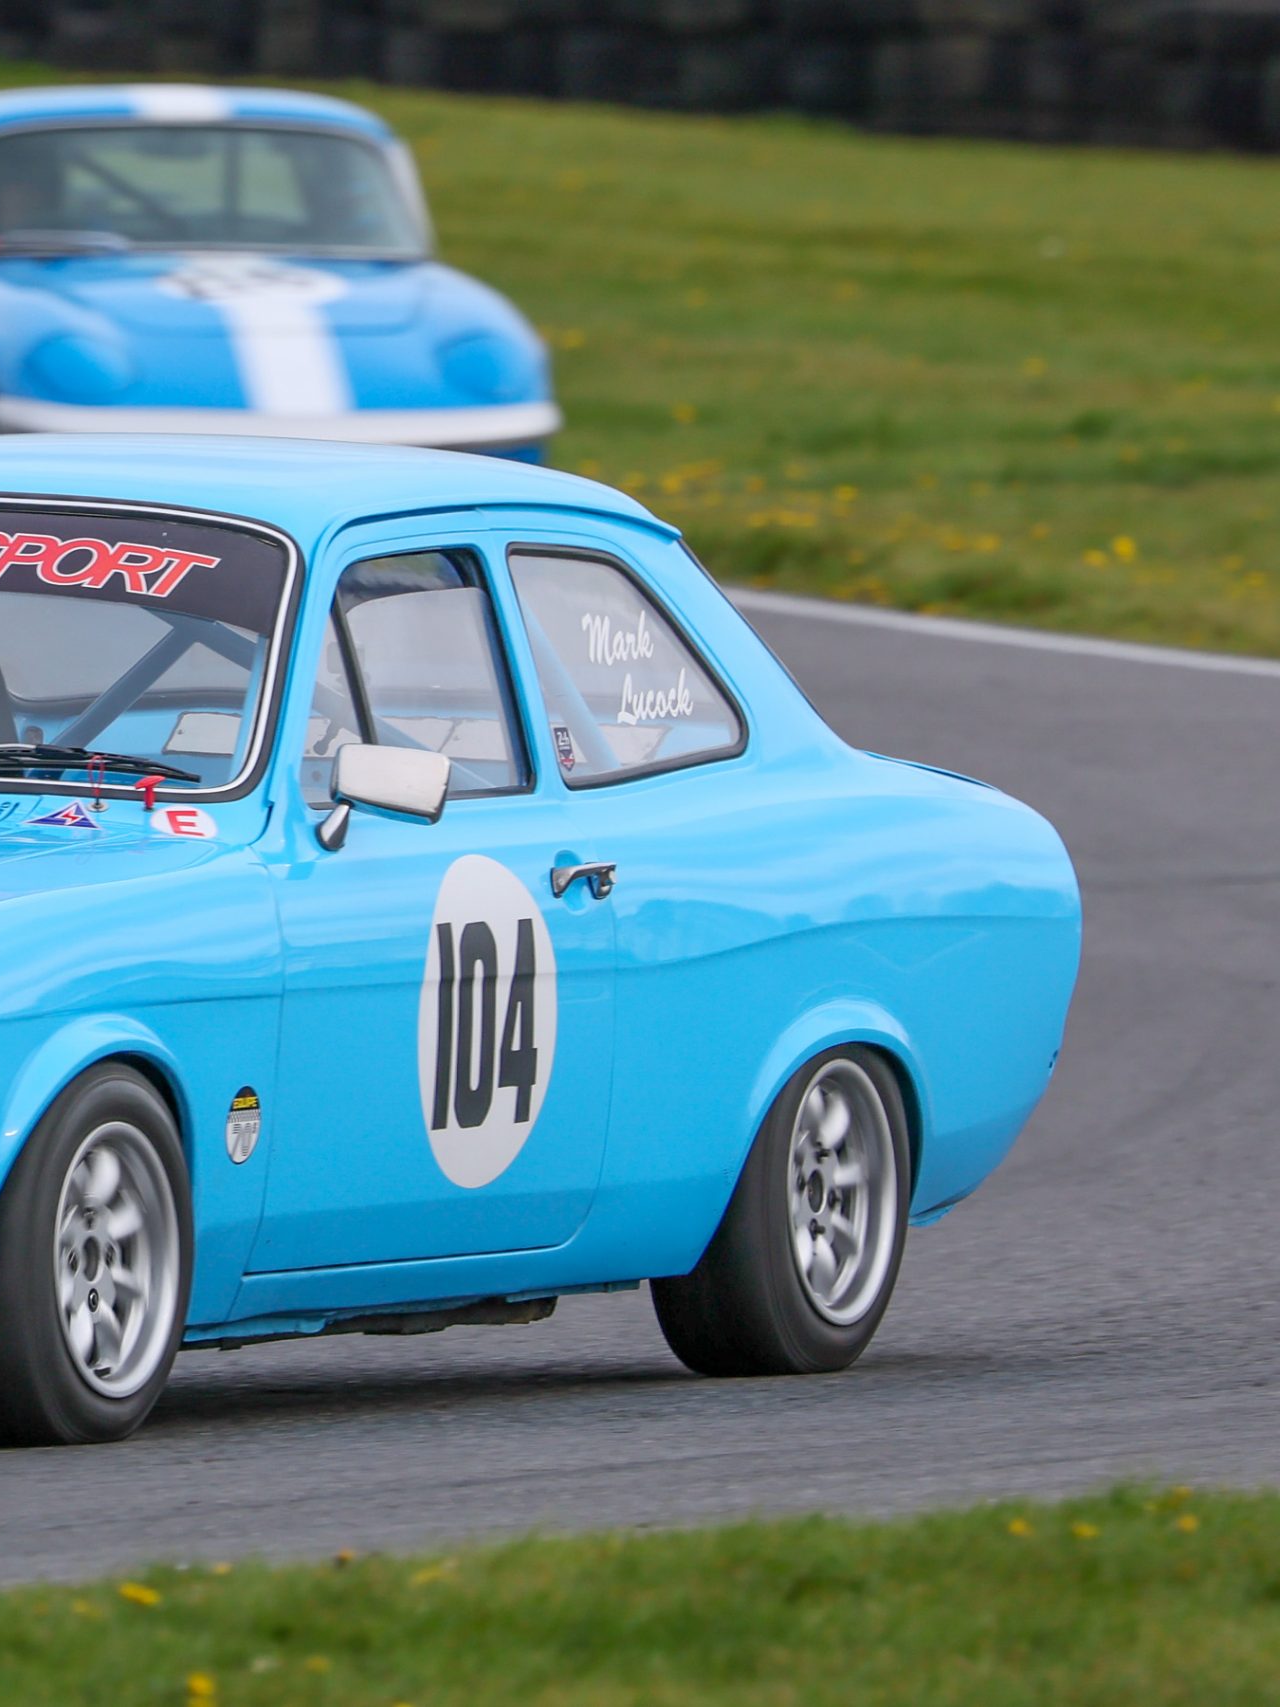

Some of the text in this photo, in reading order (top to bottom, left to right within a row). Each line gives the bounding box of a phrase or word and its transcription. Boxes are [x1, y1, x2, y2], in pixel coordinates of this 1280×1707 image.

[581, 609, 654, 666] Mark
[617, 667, 694, 725] Lucock
[166, 811, 206, 836] E
[431, 918, 538, 1131] 104
